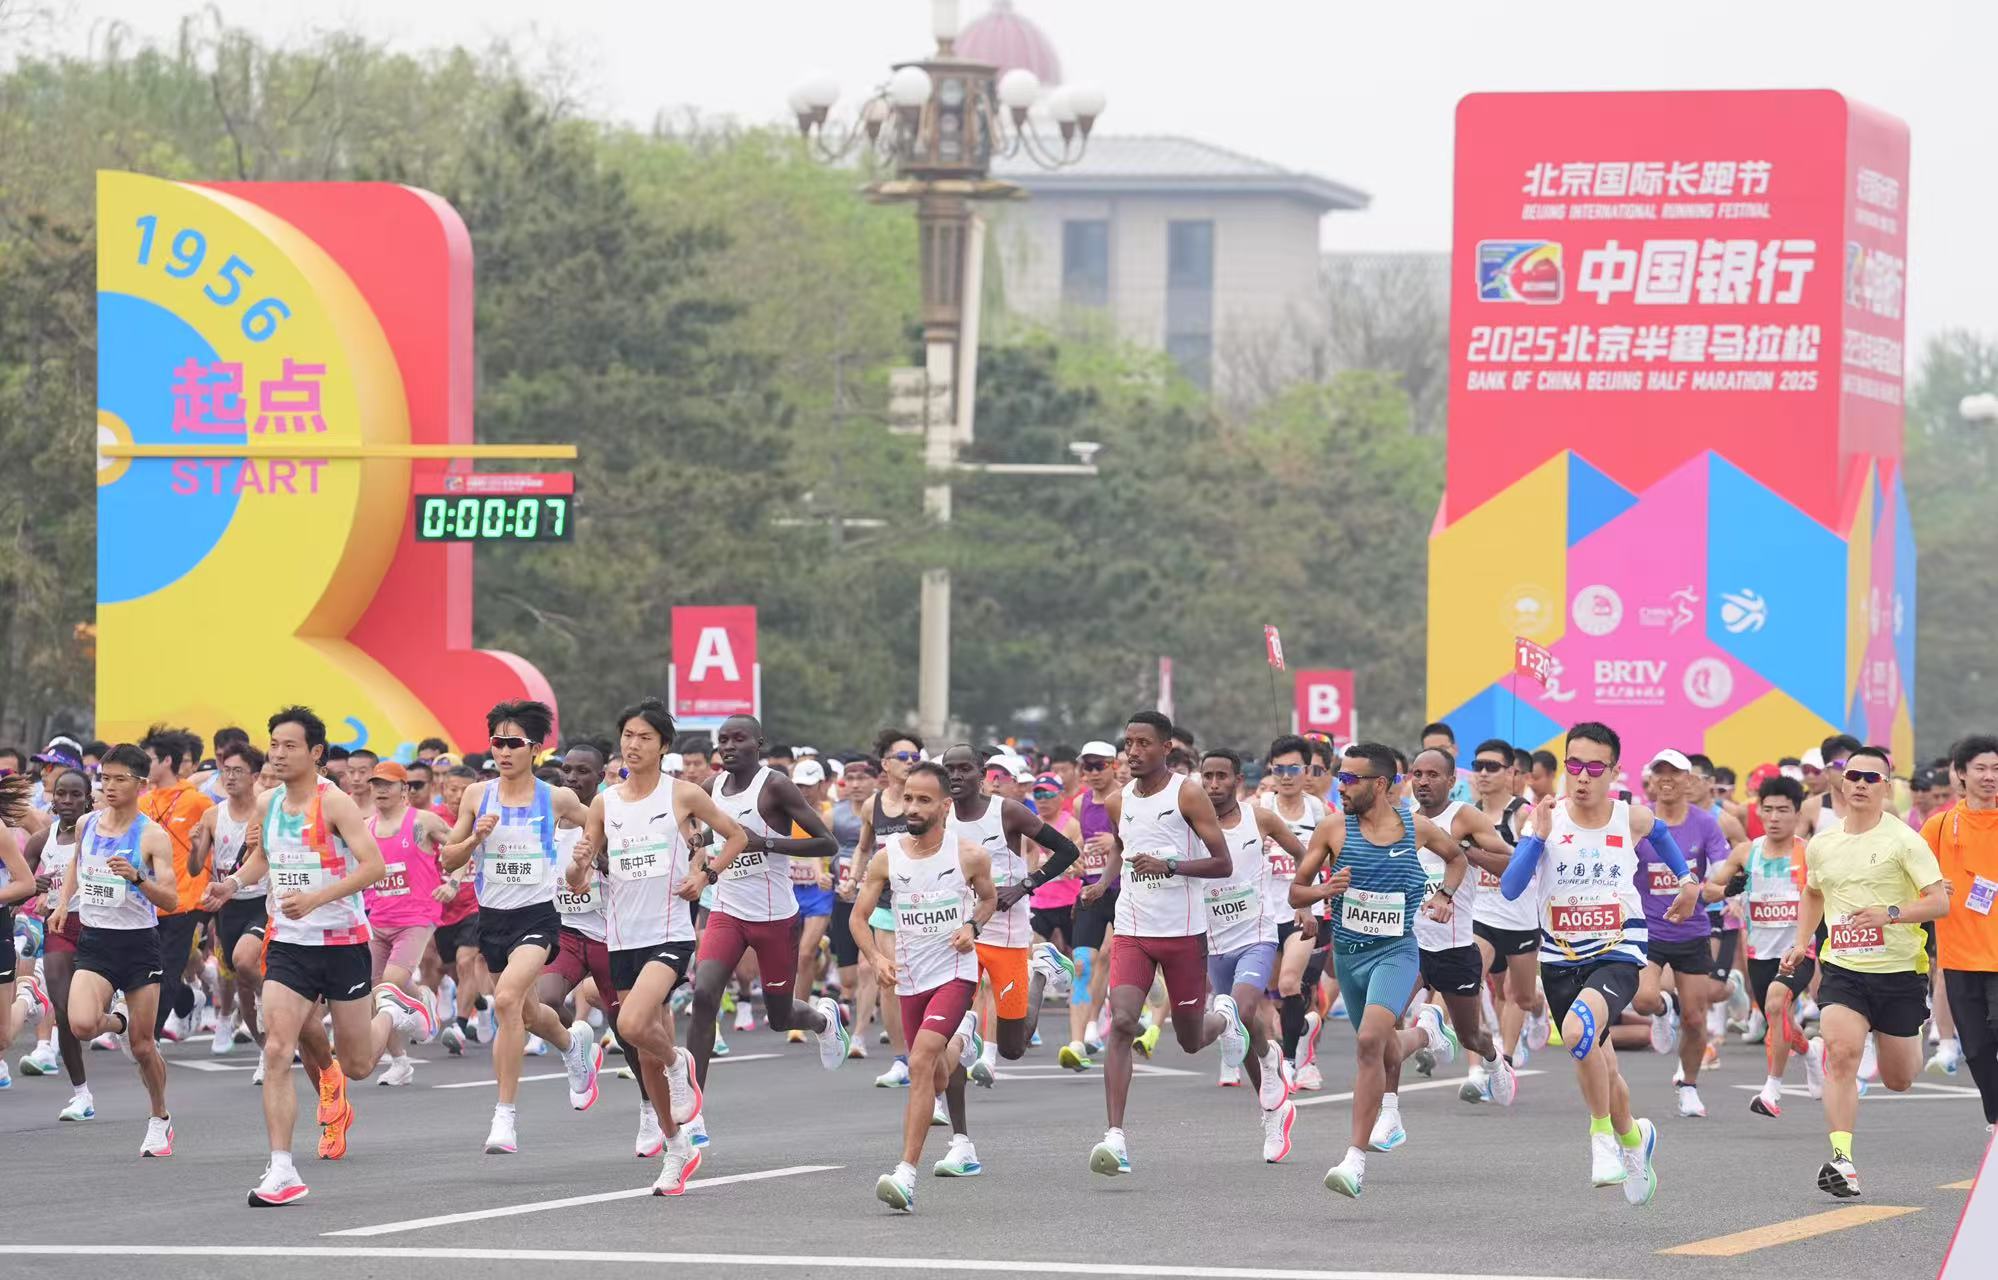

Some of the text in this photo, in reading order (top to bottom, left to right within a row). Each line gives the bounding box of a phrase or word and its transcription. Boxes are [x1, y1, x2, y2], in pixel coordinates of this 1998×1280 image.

[1522, 161, 1772, 197] 北京国际长跑节
[1522, 202, 1770, 220] BEIJING INTERNATIONAL RUNNING FESTIVAL
[135, 214, 292, 343] 1956
[1577, 238, 1816, 304] 中国银行
[1467, 324, 1820, 362] 2025北京半程马拉松
[1467, 371, 1819, 390] BANK OF CHINA BEIJING HALF MARATHON 2025
[170, 357, 328, 434] 起点
[171, 459, 329, 495] START
[422, 499, 566, 537] 0:00:07
[688, 627, 741, 681] A
[1594, 660, 1667, 684] BRTV
[1308, 684, 1341, 724] B
[496, 862, 531, 875] 赵香波
[620, 854, 656, 871] 陈中平
[728, 853, 762, 869] SGEI
[632, 870, 647, 878] 003
[1557, 862, 1621, 878] 中国警察
[278, 873, 310, 886] 王红伟
[1592, 879, 1618, 887] POLICE
[1654, 874, 1679, 886] A03
[557, 893, 591, 904] YEGO
[901, 907, 958, 925] HICHAM
[1212, 900, 1247, 916] KIDIE
[1347, 906, 1400, 924] JAAFARI
[1754, 905, 1796, 918] A0004
[1558, 911, 1615, 927] A0655
[1363, 925, 1379, 933] 020
[1833, 928, 1878, 944] A0525
